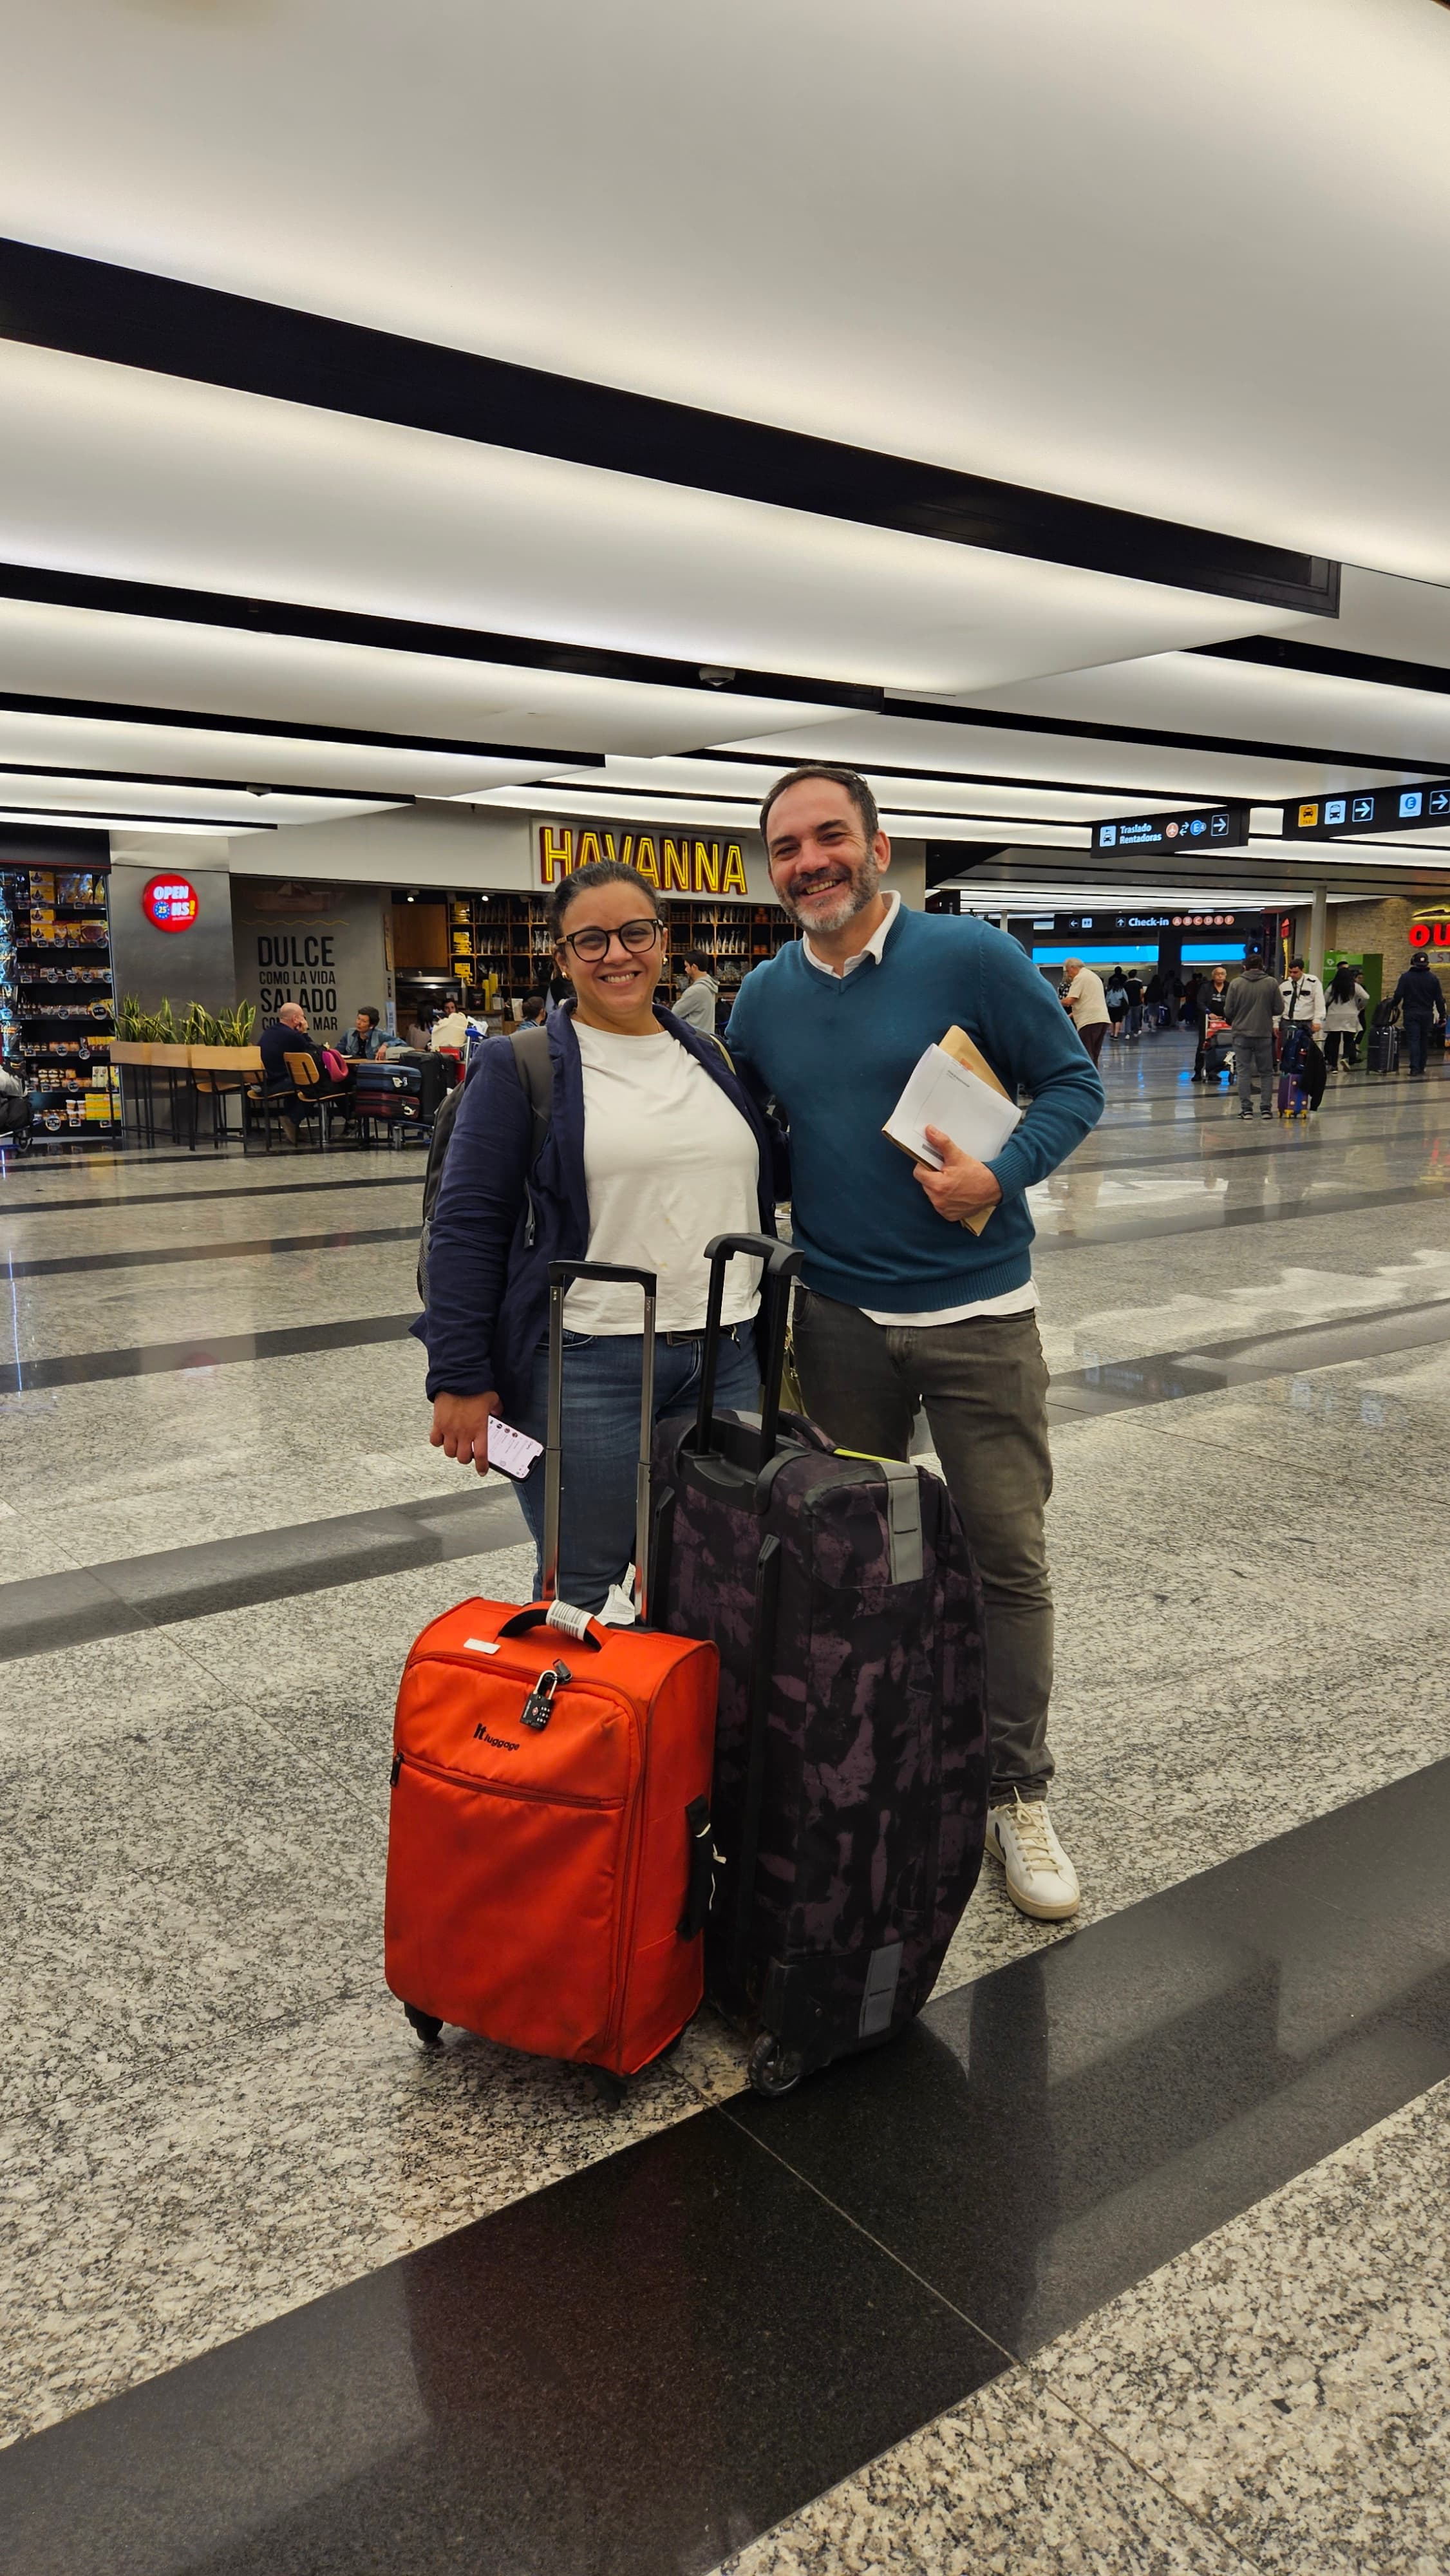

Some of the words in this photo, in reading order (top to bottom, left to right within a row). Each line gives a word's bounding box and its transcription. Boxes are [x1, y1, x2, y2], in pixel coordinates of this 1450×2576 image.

[1120, 823, 1152, 834] Traslado
[1120, 833, 1162, 844] Rentadoras
[153, 886, 189, 900] OPEN
[1128, 917, 1169, 927] Check-in
[258, 936, 335, 967] DULCE
[259, 971, 289, 985] COMO
[294, 971, 307, 985] LA
[310, 971, 335, 985] VIDA
[313, 1016, 337, 1031] MAR
[484, 1734, 520, 1751] luggage
